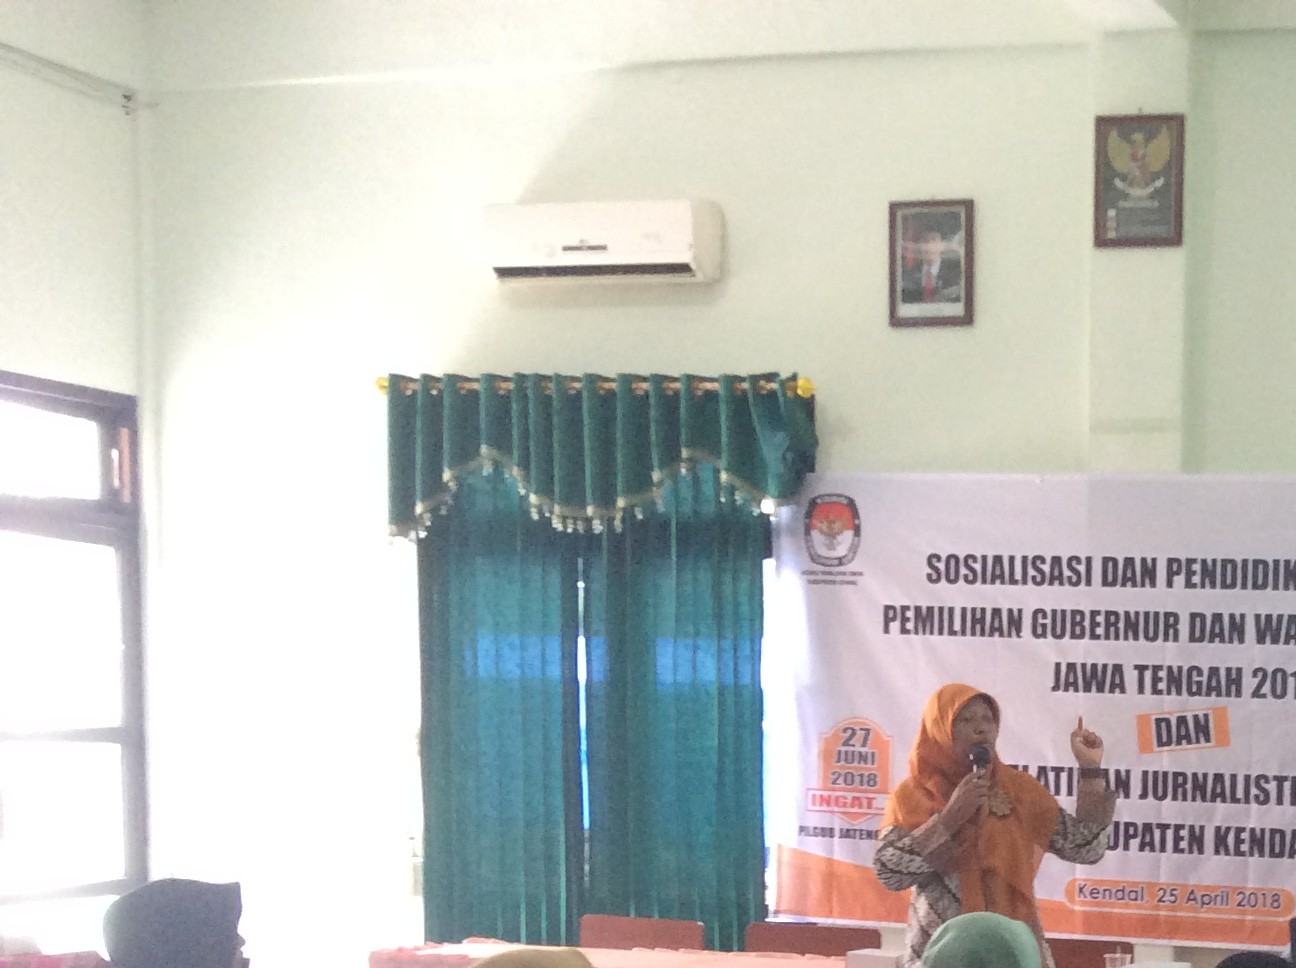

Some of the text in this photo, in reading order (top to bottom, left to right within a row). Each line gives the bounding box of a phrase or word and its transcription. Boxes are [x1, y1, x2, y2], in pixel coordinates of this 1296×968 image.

[926, 553, 1093, 588] SOSIALISASI
[1101, 556, 1157, 589] DAN
[883, 604, 1023, 639] PEMILIHAN
[1031, 608, 1179, 643] GUBERNUR
[1189, 611, 1245, 645] DAN
[1051, 662, 1126, 695] JAWA
[1135, 664, 1242, 698] TENGAH
[841, 726, 871, 748] 27
[1155, 712, 1212, 748] DAN
[835, 750, 876, 766] JUNI
[831, 771, 878, 788] 2018
[1106, 821, 1205, 855] UPATEN
[1157, 887, 1178, 904] 25
[1184, 889, 1229, 909] April
[1236, 891, 1282, 910] 2018
